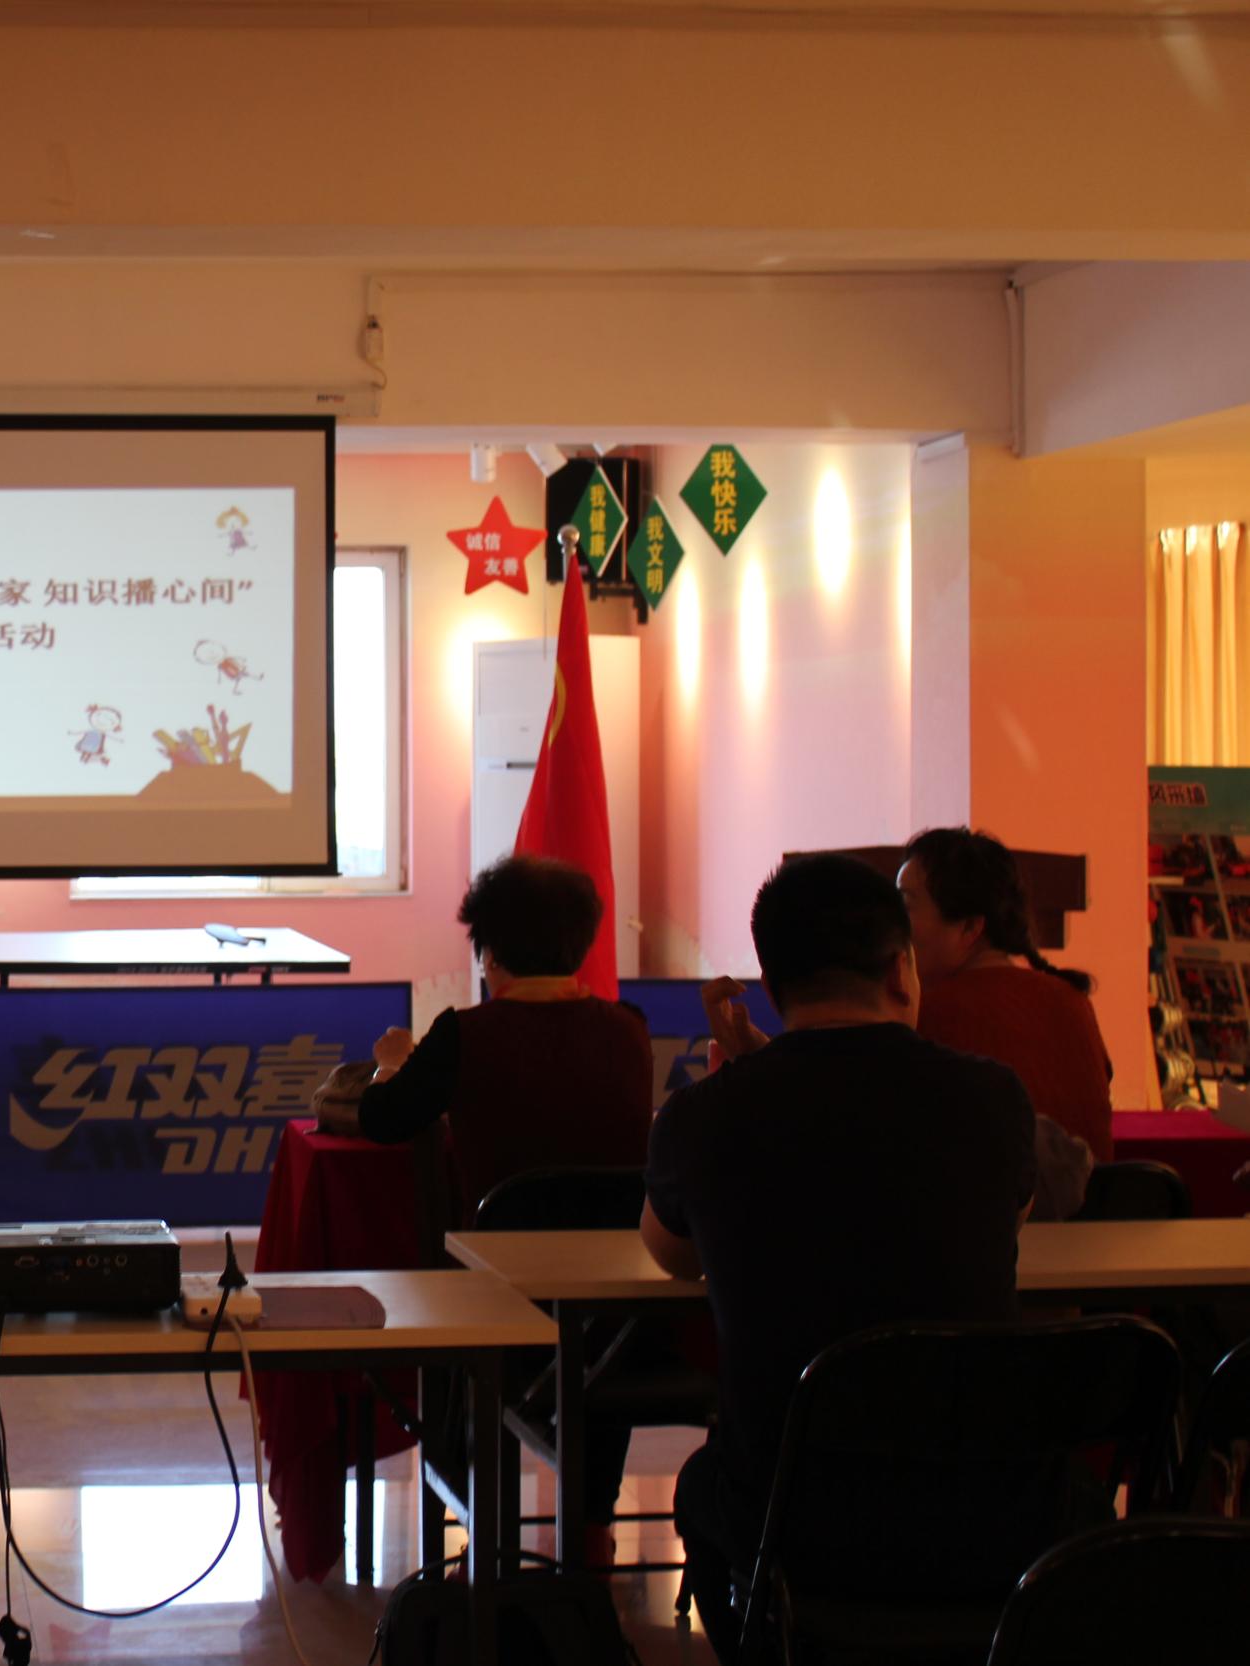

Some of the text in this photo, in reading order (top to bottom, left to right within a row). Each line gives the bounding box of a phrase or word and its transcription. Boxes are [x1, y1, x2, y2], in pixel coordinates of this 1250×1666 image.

[710, 451, 737, 536] 我快乐
[466, 532, 501, 551] 诚信
[646, 515, 664, 594] 我文明
[484, 557, 518, 576] 友善
[154, 1126, 286, 1175] DH
